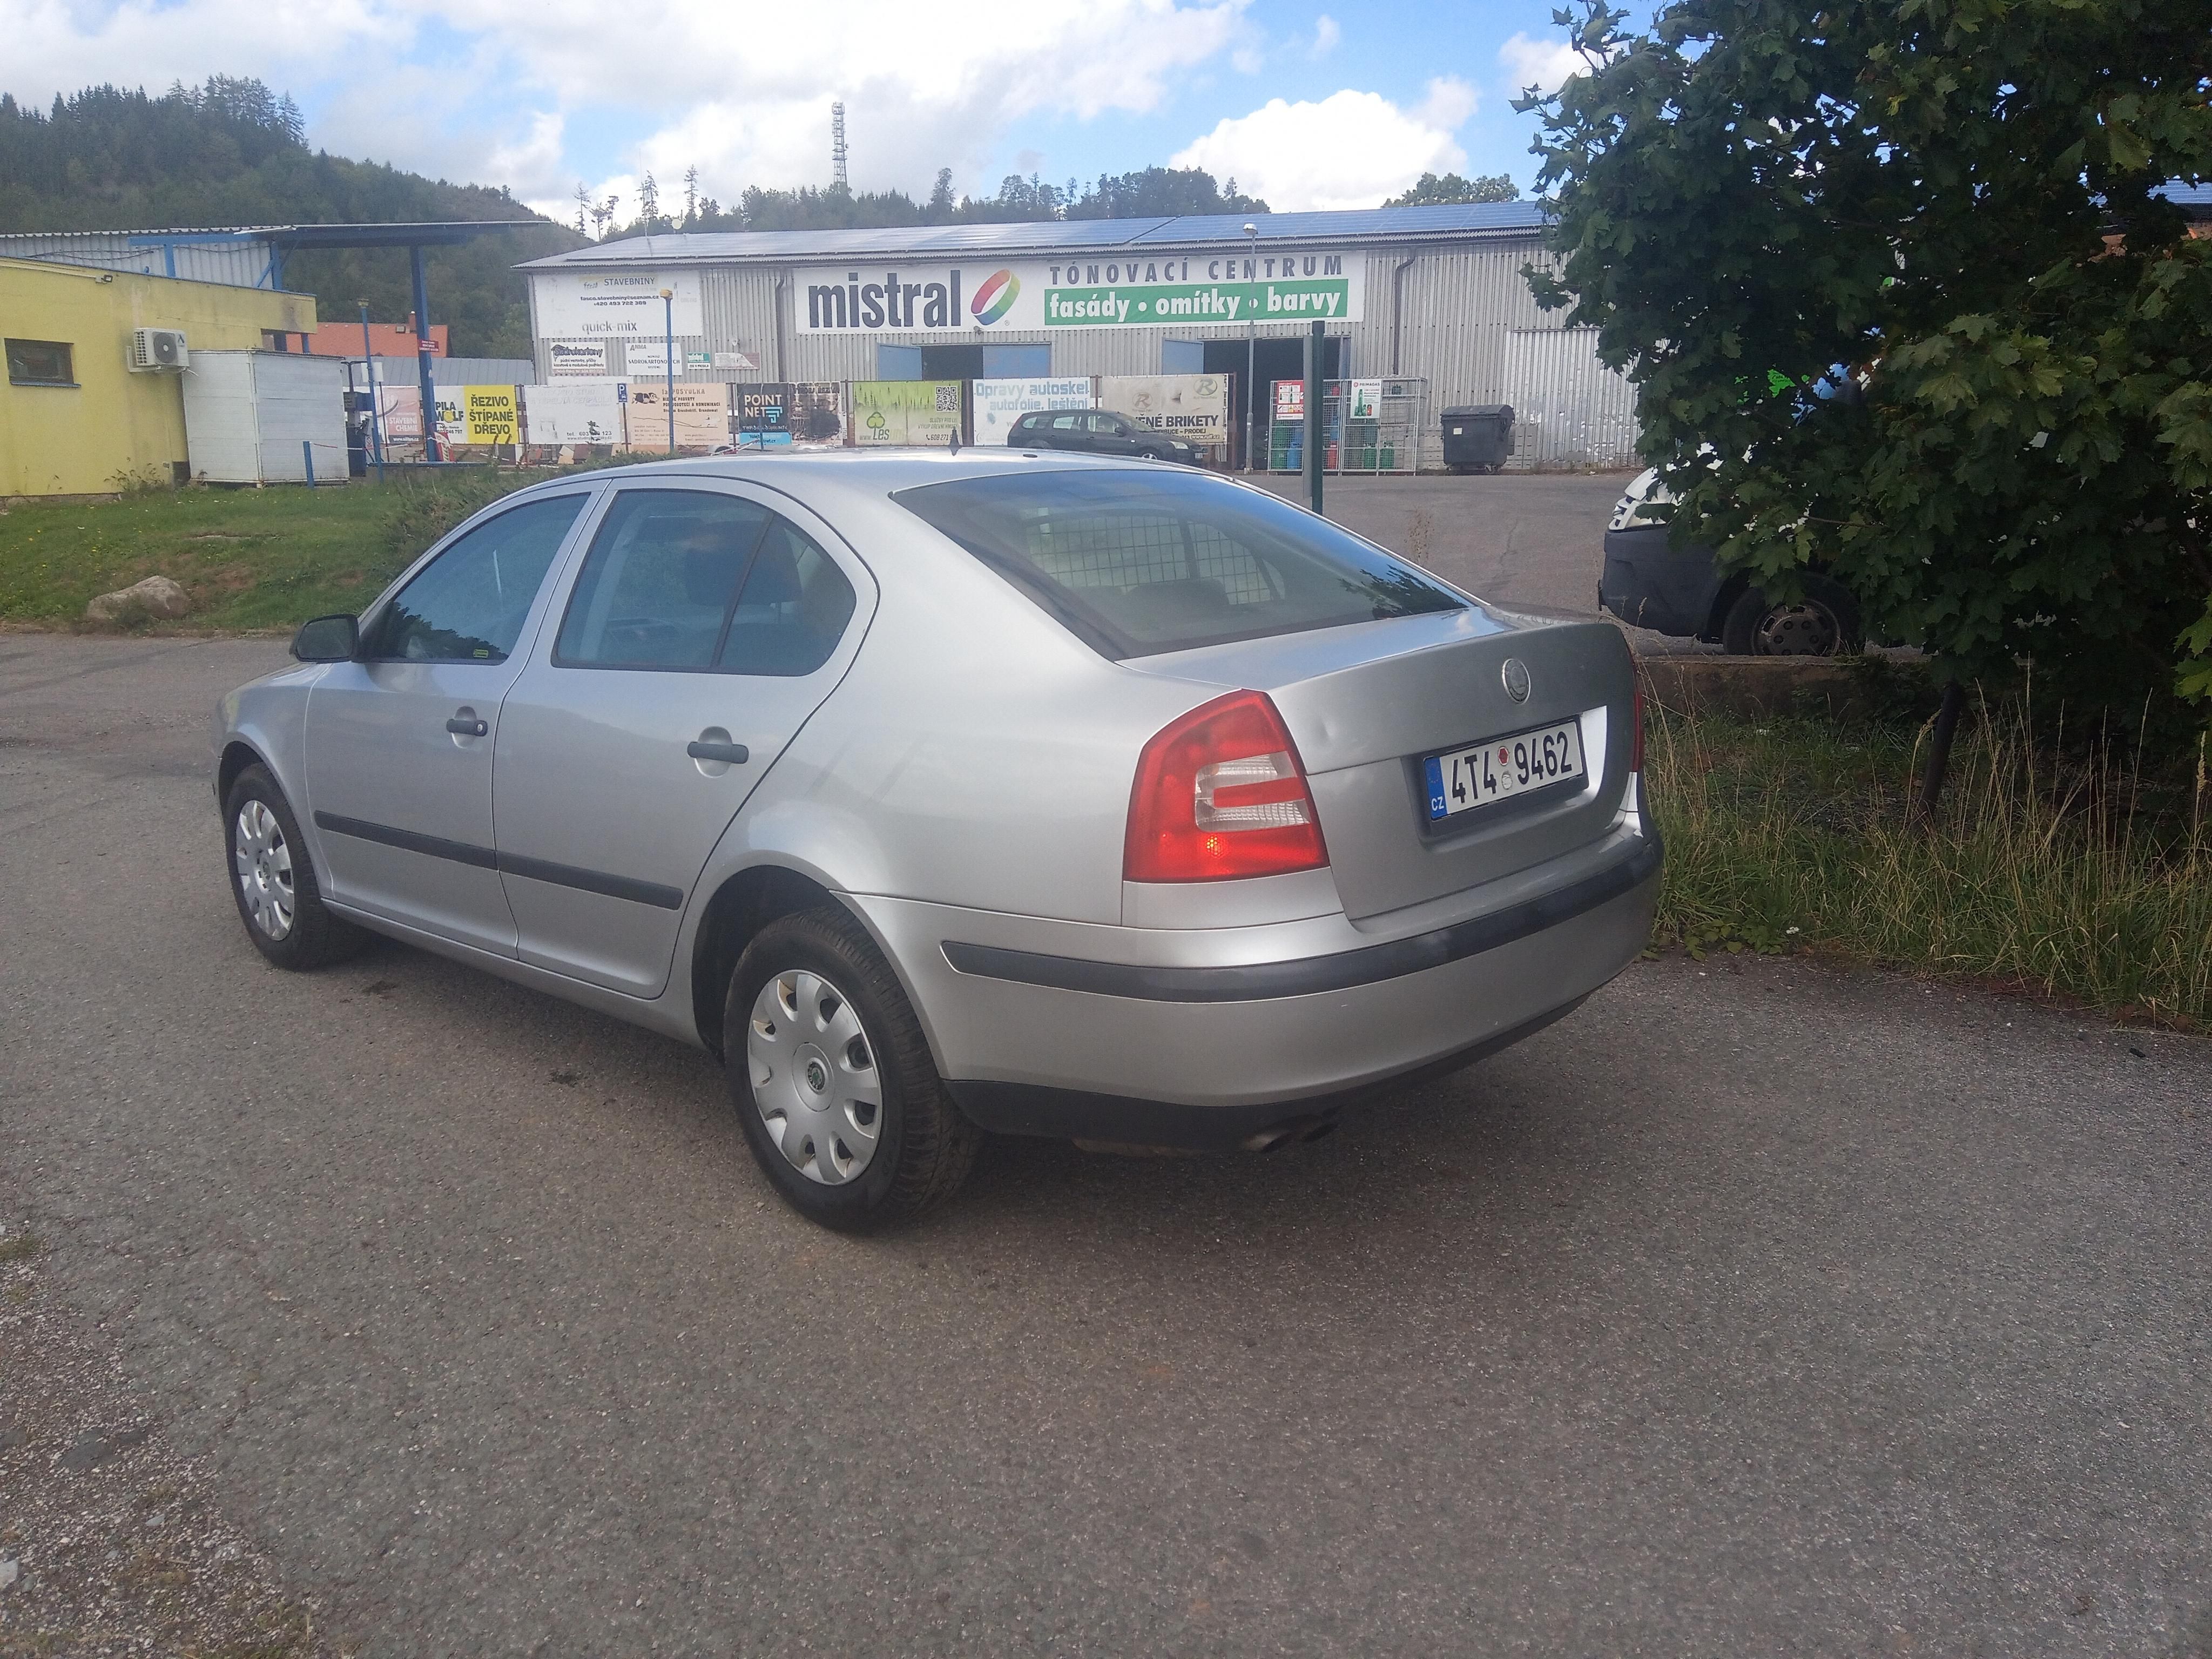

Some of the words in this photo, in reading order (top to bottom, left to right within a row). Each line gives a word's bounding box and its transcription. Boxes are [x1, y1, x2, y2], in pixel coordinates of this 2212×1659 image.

[1050, 257, 1188, 285] TÓNOVACÍ
[1209, 255, 1342, 280] CENTRUM
[604, 278, 655, 286] STAVEBNINY
[808, 270, 961, 328] mistral
[1050, 292, 1130, 322] fasády
[1156, 288, 1241, 320] omítky
[1267, 286, 1341, 316] barvy
[619, 385, 625, 394] P
[976, 382, 1024, 399] Opravy
[1030, 381, 1088, 395] autoskel
[435, 402, 456, 410] PILA
[471, 394, 509, 407] ŘEZIVO
[744, 394, 783, 406] POINT
[1048, 397, 1088, 410] leštění
[469, 409, 514, 422] ŠTÍPANÉ
[745, 407, 766, 418] NET
[1166, 415, 1219, 427] BRIKETY
[474, 422, 510, 434] DŘEVO
[1452, 751, 1497, 804] 4T4
[1514, 731, 1573, 785] 9462
[1431, 796, 1445, 811] CZ
